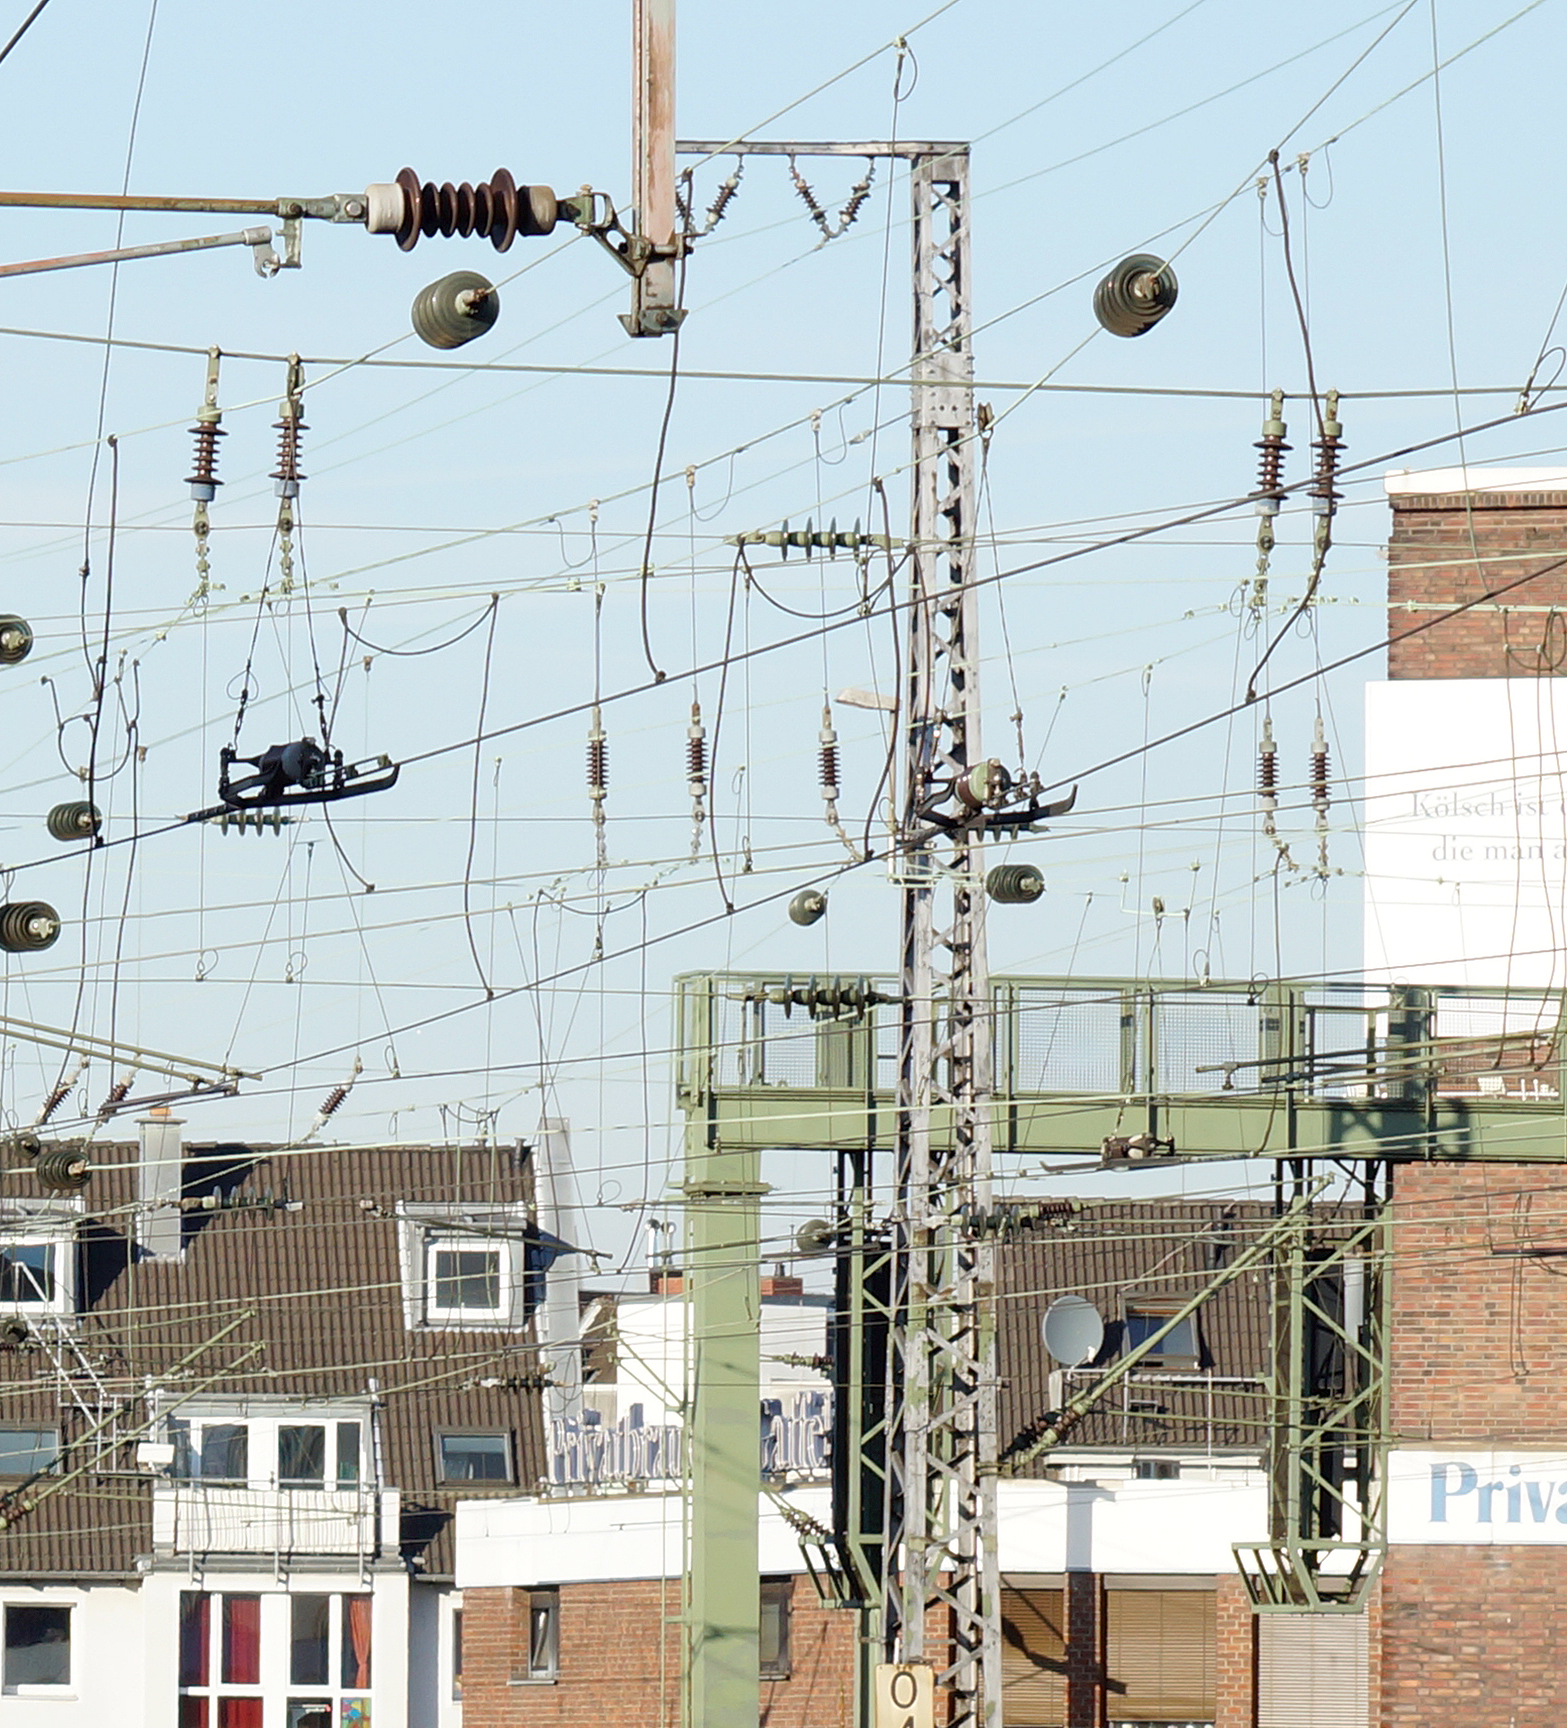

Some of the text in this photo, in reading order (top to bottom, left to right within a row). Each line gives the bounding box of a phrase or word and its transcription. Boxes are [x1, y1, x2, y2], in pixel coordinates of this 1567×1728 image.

[1412, 792, 1505, 818] Kölsch
[1432, 834, 1473, 861] die
[1484, 845, 1544, 860] man
